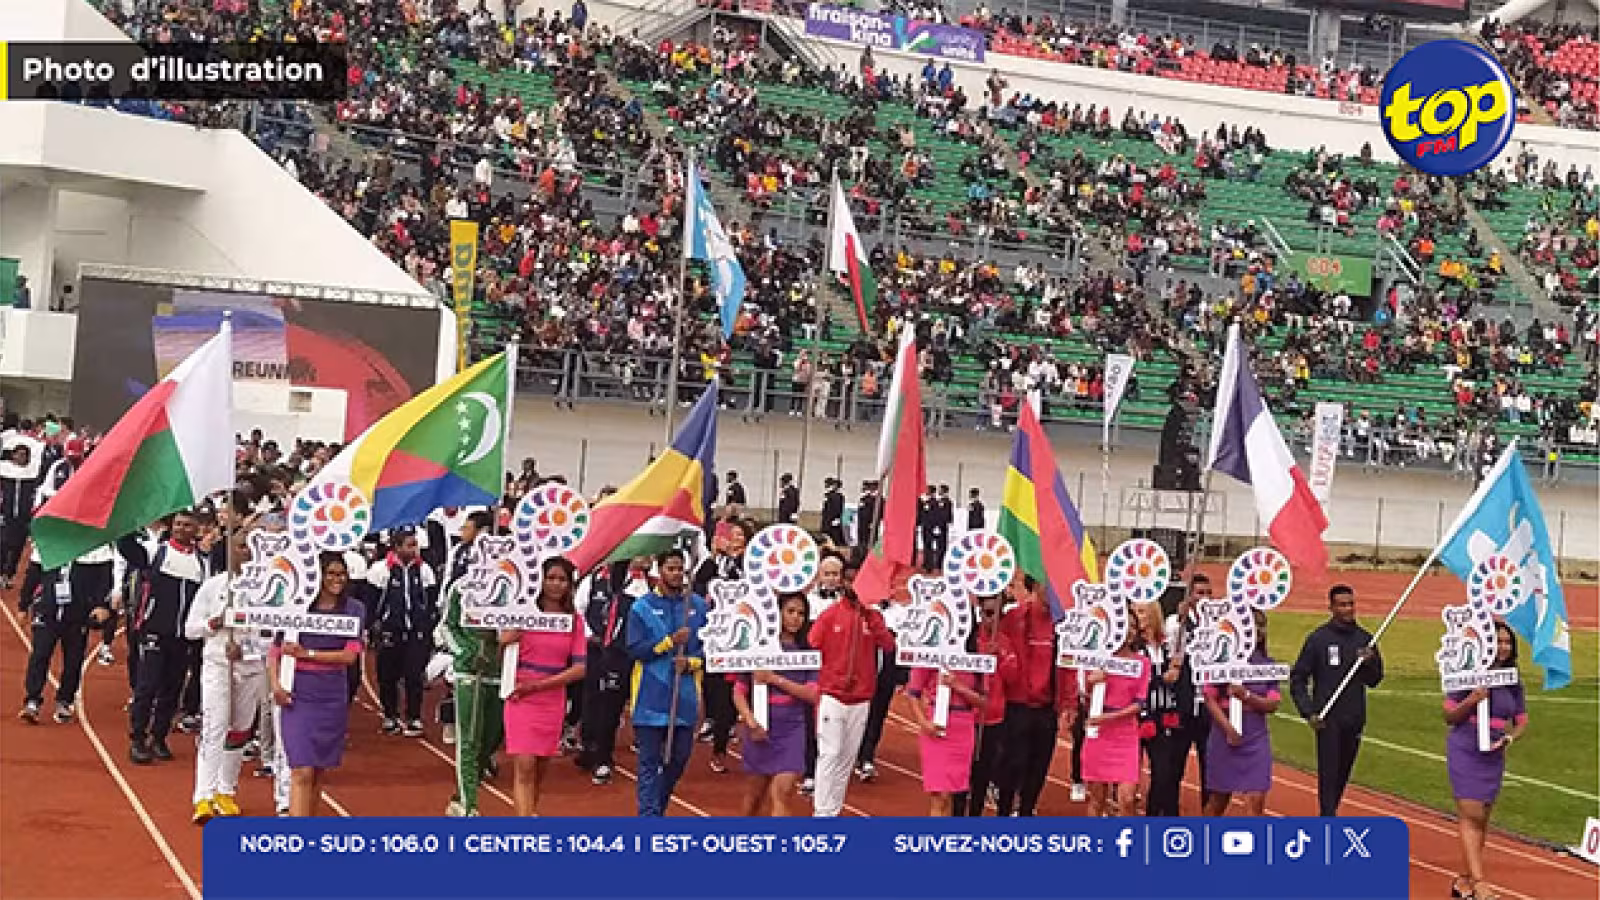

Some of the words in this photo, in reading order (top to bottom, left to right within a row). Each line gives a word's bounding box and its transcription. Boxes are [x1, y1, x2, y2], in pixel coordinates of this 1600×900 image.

[249, 613, 355, 633] MADAGASCAR
[483, 613, 569, 628] COMORES
[727, 654, 818, 668] SEYCHELLES
[915, 652, 992, 671] MALDIVES
[1076, 656, 1139, 673] MAURICE
[1212, 669, 1227, 681] LA
[1459, 671, 1515, 686] MAYOTTE
